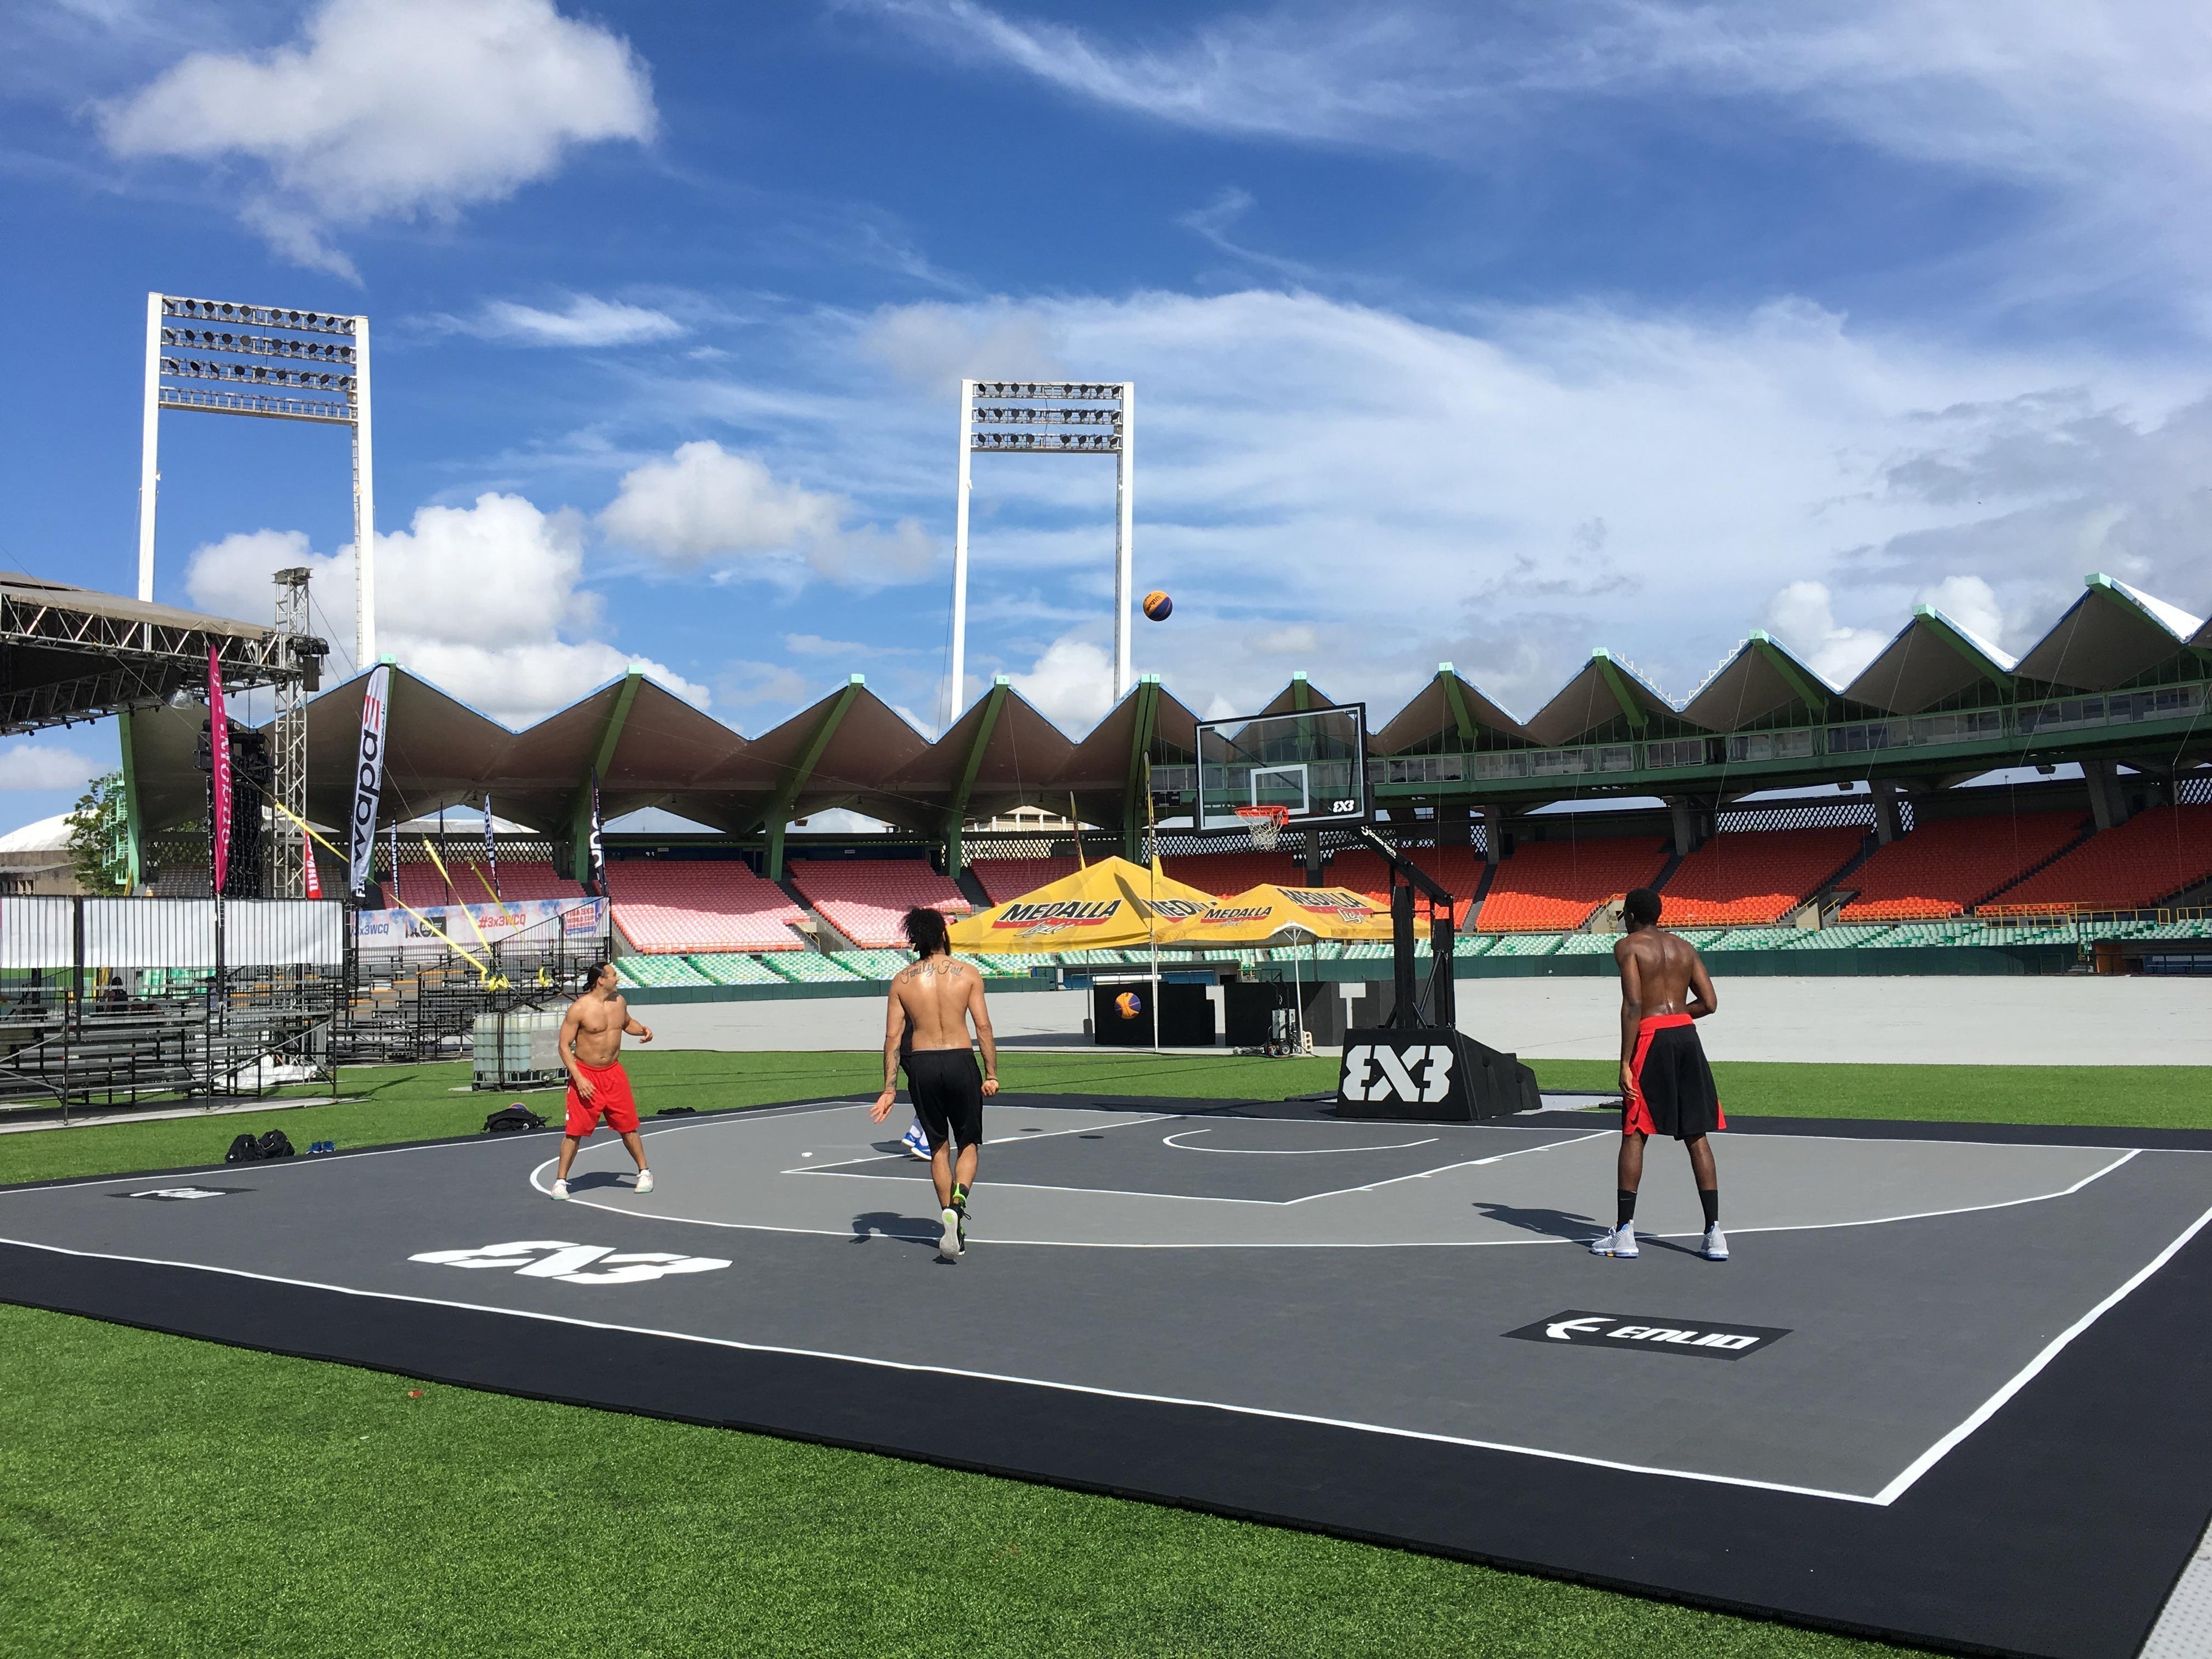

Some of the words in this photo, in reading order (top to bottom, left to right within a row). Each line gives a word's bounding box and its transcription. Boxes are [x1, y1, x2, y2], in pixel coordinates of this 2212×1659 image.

[354, 729, 380, 868] wapa
[1276, 888, 1370, 908] MEDALLA
[998, 899, 1124, 922] MEDALLA
[1203, 906, 1273, 919] MEDALLA
[350, 923, 389, 936] x3WCQ
[478, 914, 527, 929] #3x3WCQ
[900, 961, 936, 984] Family
[937, 960, 964, 977] First
